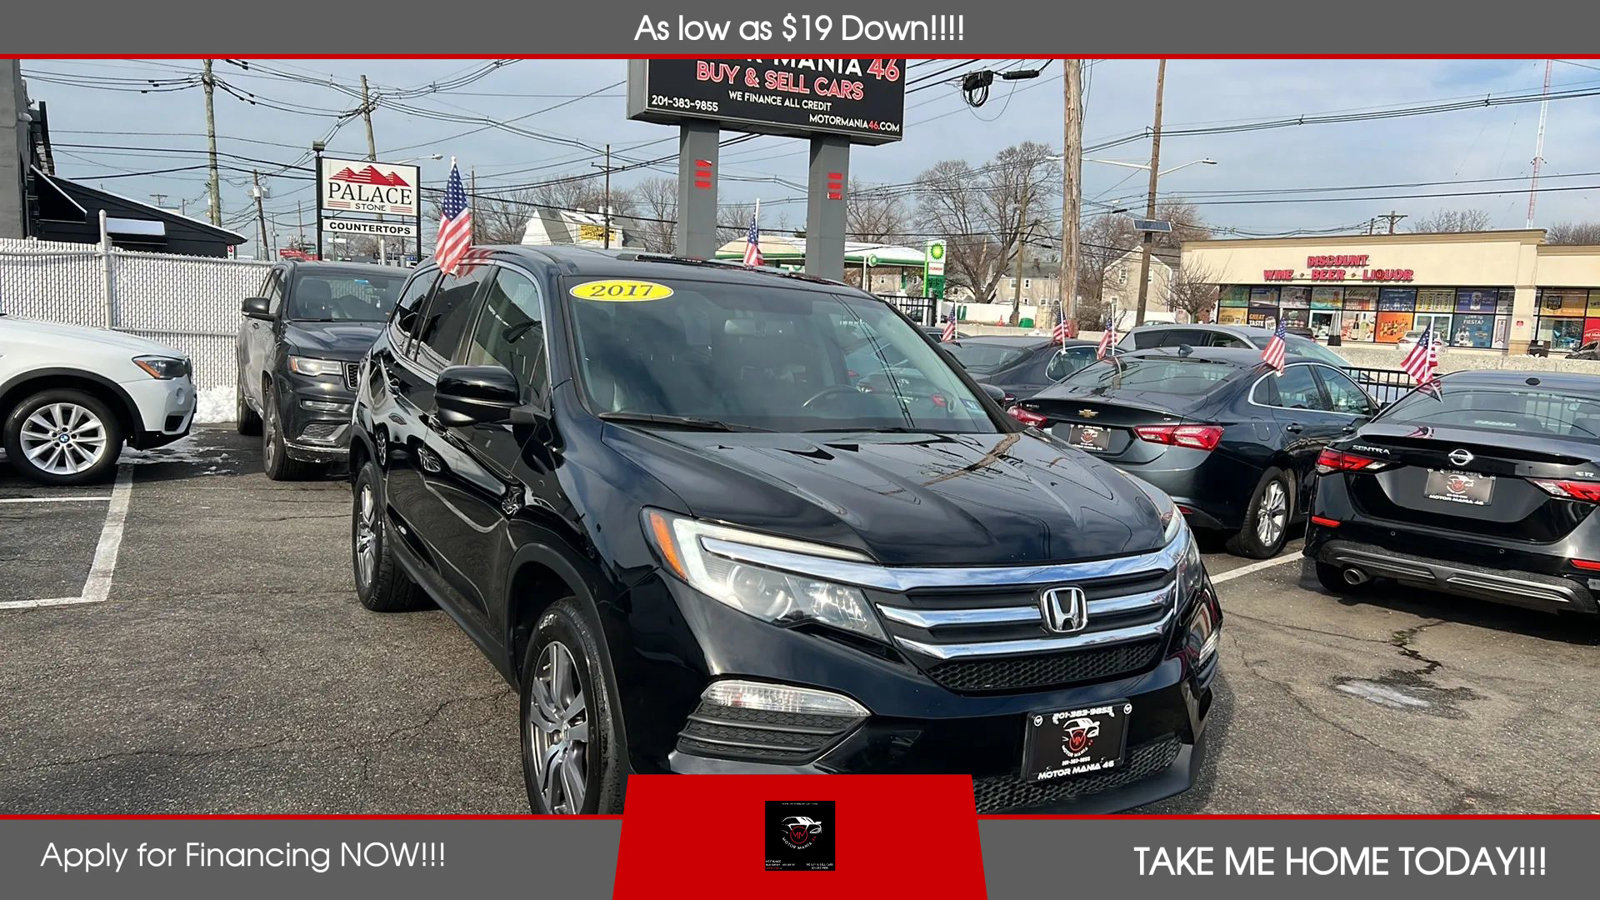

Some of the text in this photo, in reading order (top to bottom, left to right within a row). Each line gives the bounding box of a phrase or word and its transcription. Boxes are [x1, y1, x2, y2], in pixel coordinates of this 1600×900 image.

[696, 60, 864, 101] BUY & SELL CARS
[651, 94, 719, 112] 201-383-9855
[729, 90, 832, 111] WE FINANCE ALL CREDIT
[809, 113, 900, 133] MOTORMANIA46.COM
[328, 181, 413, 206] PALACE
[355, 202, 387, 212] STONE
[329, 221, 411, 235] COUNTERTOPS
[1307, 255, 1370, 268] DISCOUNT
[1264, 269, 1414, 282] WINE BEER LIQUOR
[590, 284, 654, 297] 2017
[1352, 444, 1391, 455] SENTRA
[1037, 760, 1115, 780] MOTOR MANIA 46
